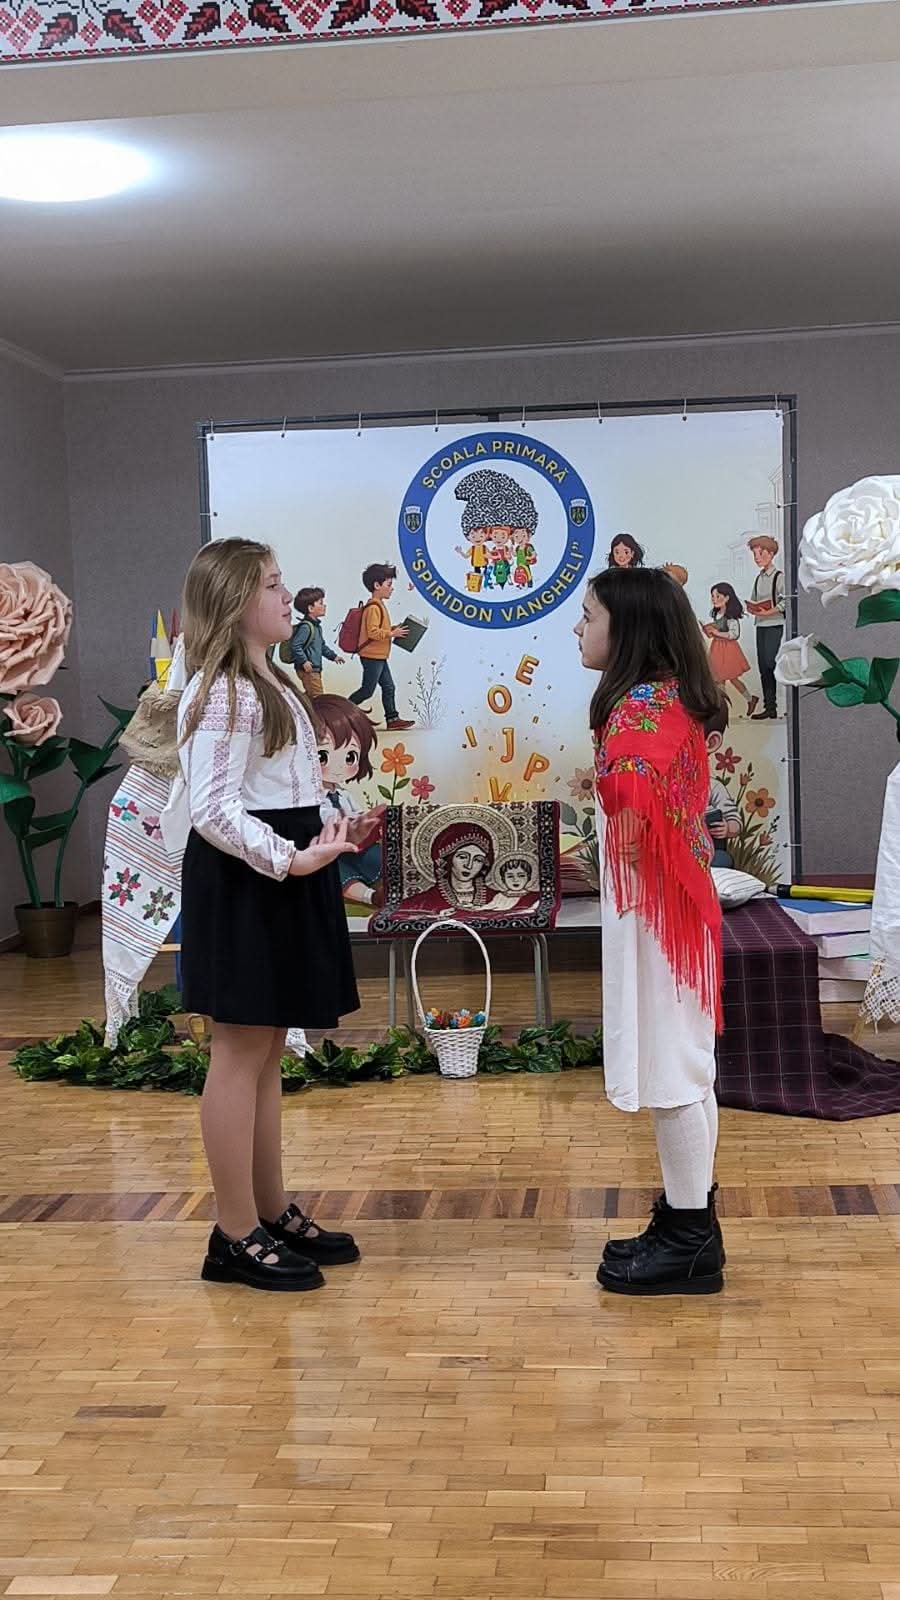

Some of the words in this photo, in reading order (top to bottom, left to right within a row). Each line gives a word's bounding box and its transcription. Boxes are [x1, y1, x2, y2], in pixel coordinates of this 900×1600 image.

[492, 440, 568, 483] PRIMARĂ
[515, 654, 540, 686] E
[487, 684, 513, 714] O
[500, 727, 515, 763] J
[523, 752, 550, 782] P
